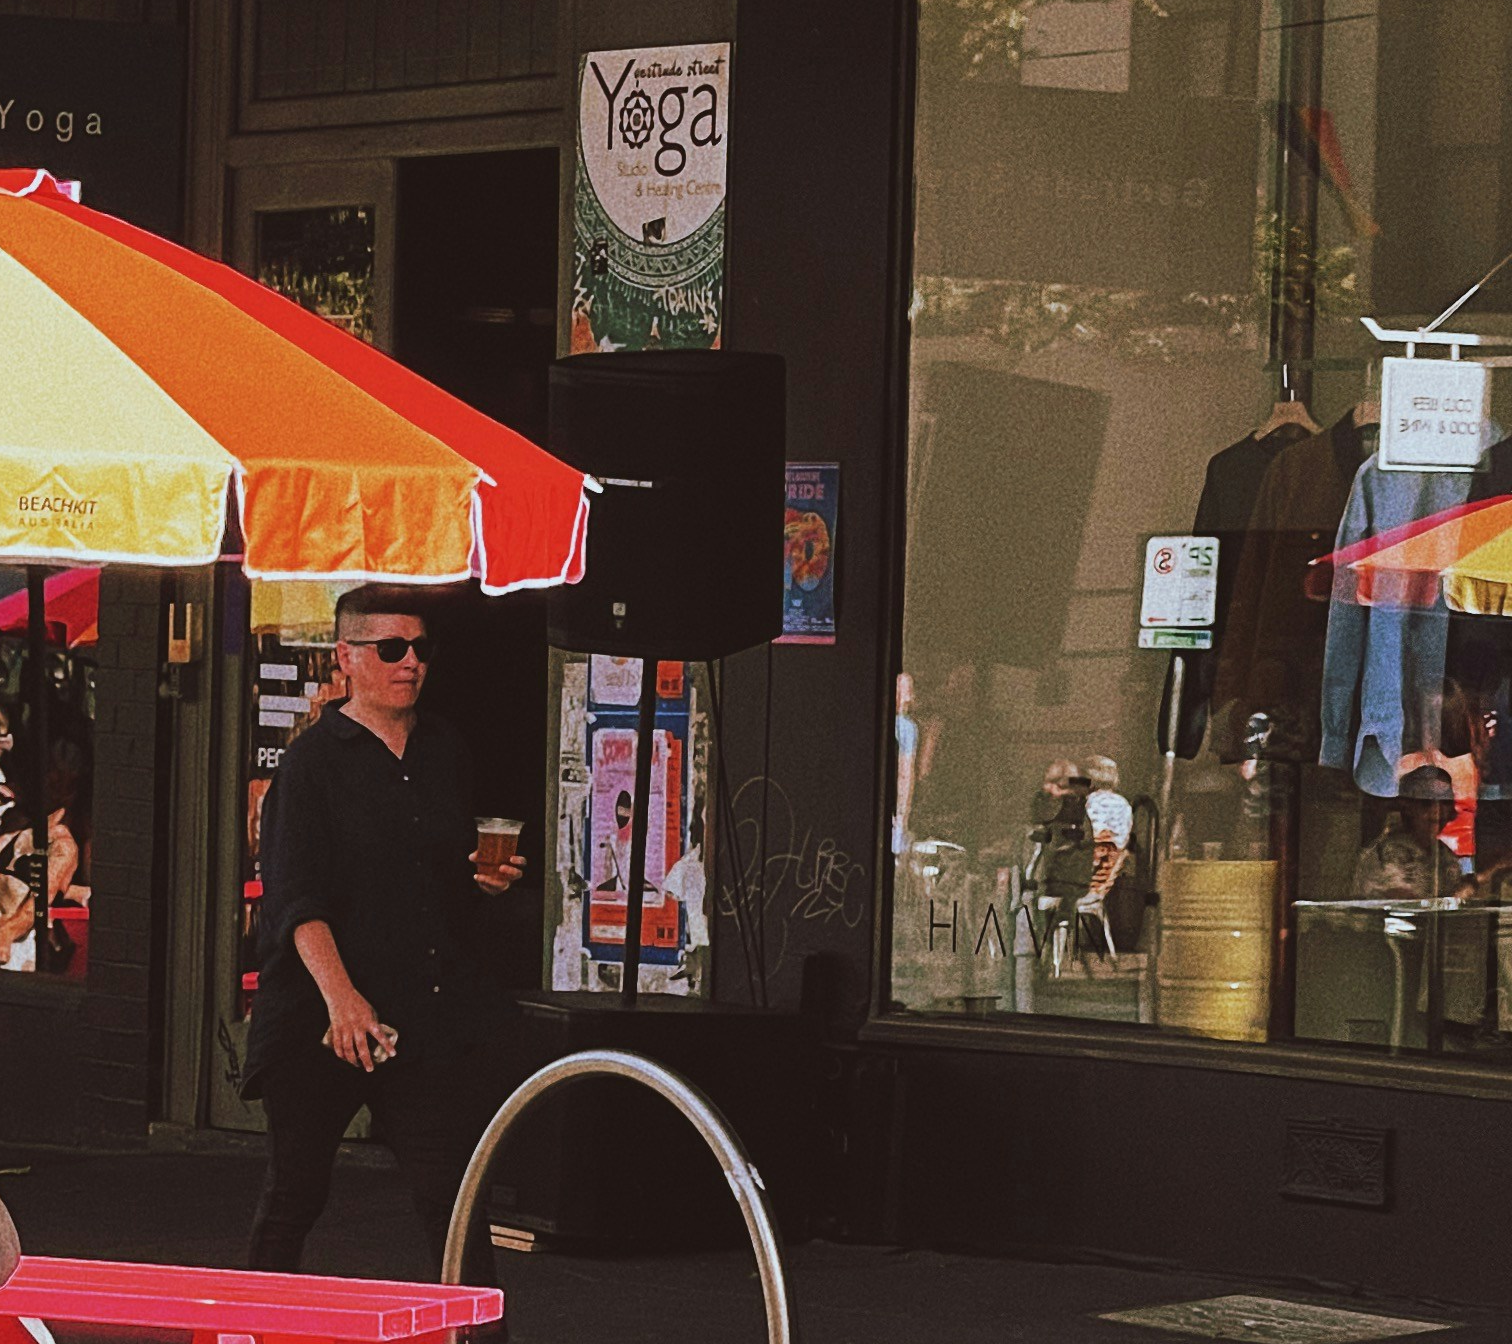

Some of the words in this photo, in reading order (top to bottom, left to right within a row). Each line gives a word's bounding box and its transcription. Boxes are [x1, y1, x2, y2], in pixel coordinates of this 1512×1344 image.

[687, 56, 725, 76] street
[590, 58, 722, 177] Yoga
[646, 181, 683, 200] Healing
[687, 179, 722, 196] Centre
[785, 483, 825, 500] RIDE
[18, 496, 97, 515] BEACHKIT
[18, 517, 94, 530] AUSRALIA
